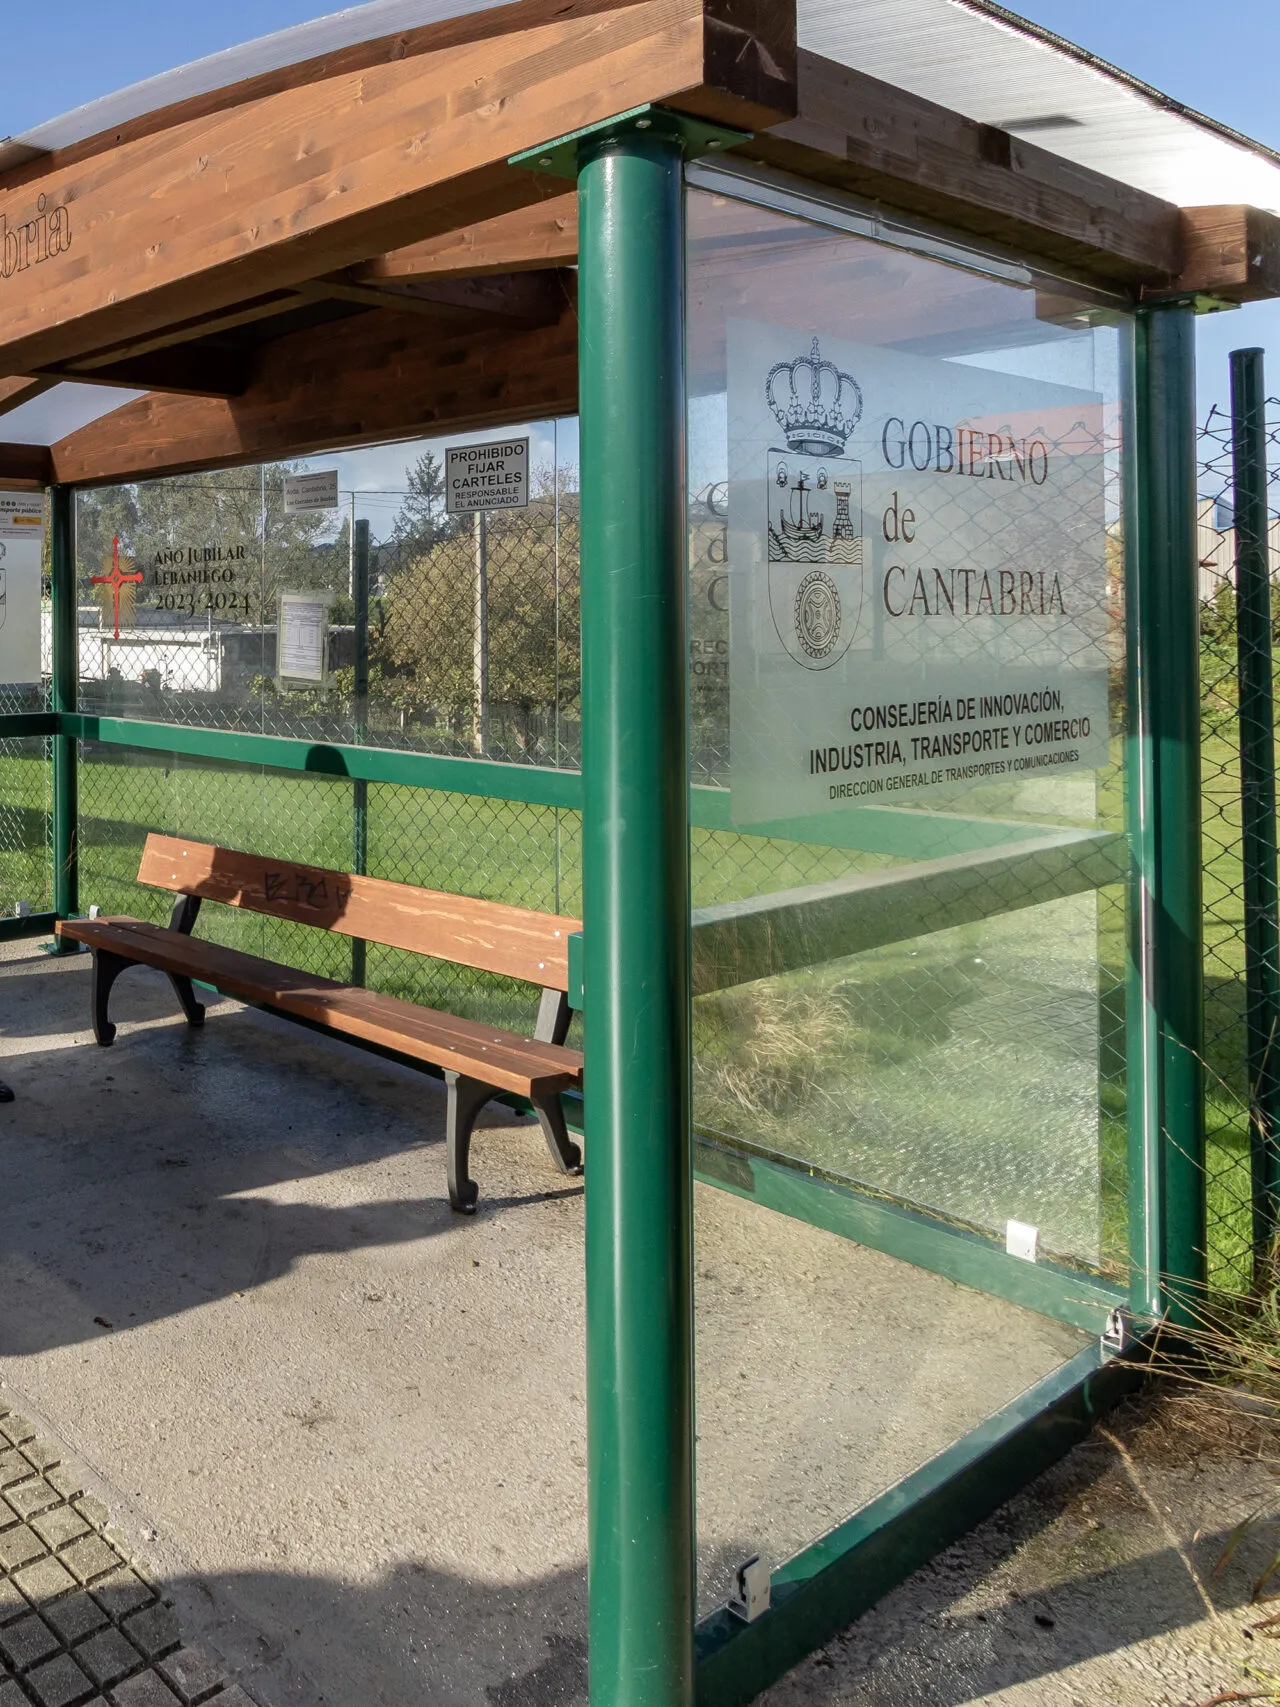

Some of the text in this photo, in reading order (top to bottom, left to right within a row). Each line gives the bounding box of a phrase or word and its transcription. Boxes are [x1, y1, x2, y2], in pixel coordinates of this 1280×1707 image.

[451, 444, 524, 463] PROHIBIDO
[881, 417, 1048, 485] GOBIERNO
[467, 460, 505, 475] FIJAR
[452, 472, 522, 489] CARTELES
[455, 486, 520, 499] RESPONSABLE
[455, 496, 519, 509] EL ANUNCIADO
[882, 491, 916, 543] de
[154, 545, 245, 566] AÑO JUBILAR
[155, 568, 234, 586] LEBANIEGO
[882, 566, 1067, 618] CANTABRIA
[850, 686, 1065, 732] CONSEJERÍA DE INNOVACIÓN,
[810, 717, 1091, 774] INDUSTRIA, TRANSPORTE Y COMERCIO
[829, 750, 1080, 800] DIRECCION GENERAL DE TRANSPORTES Y COMUNICACIONES
